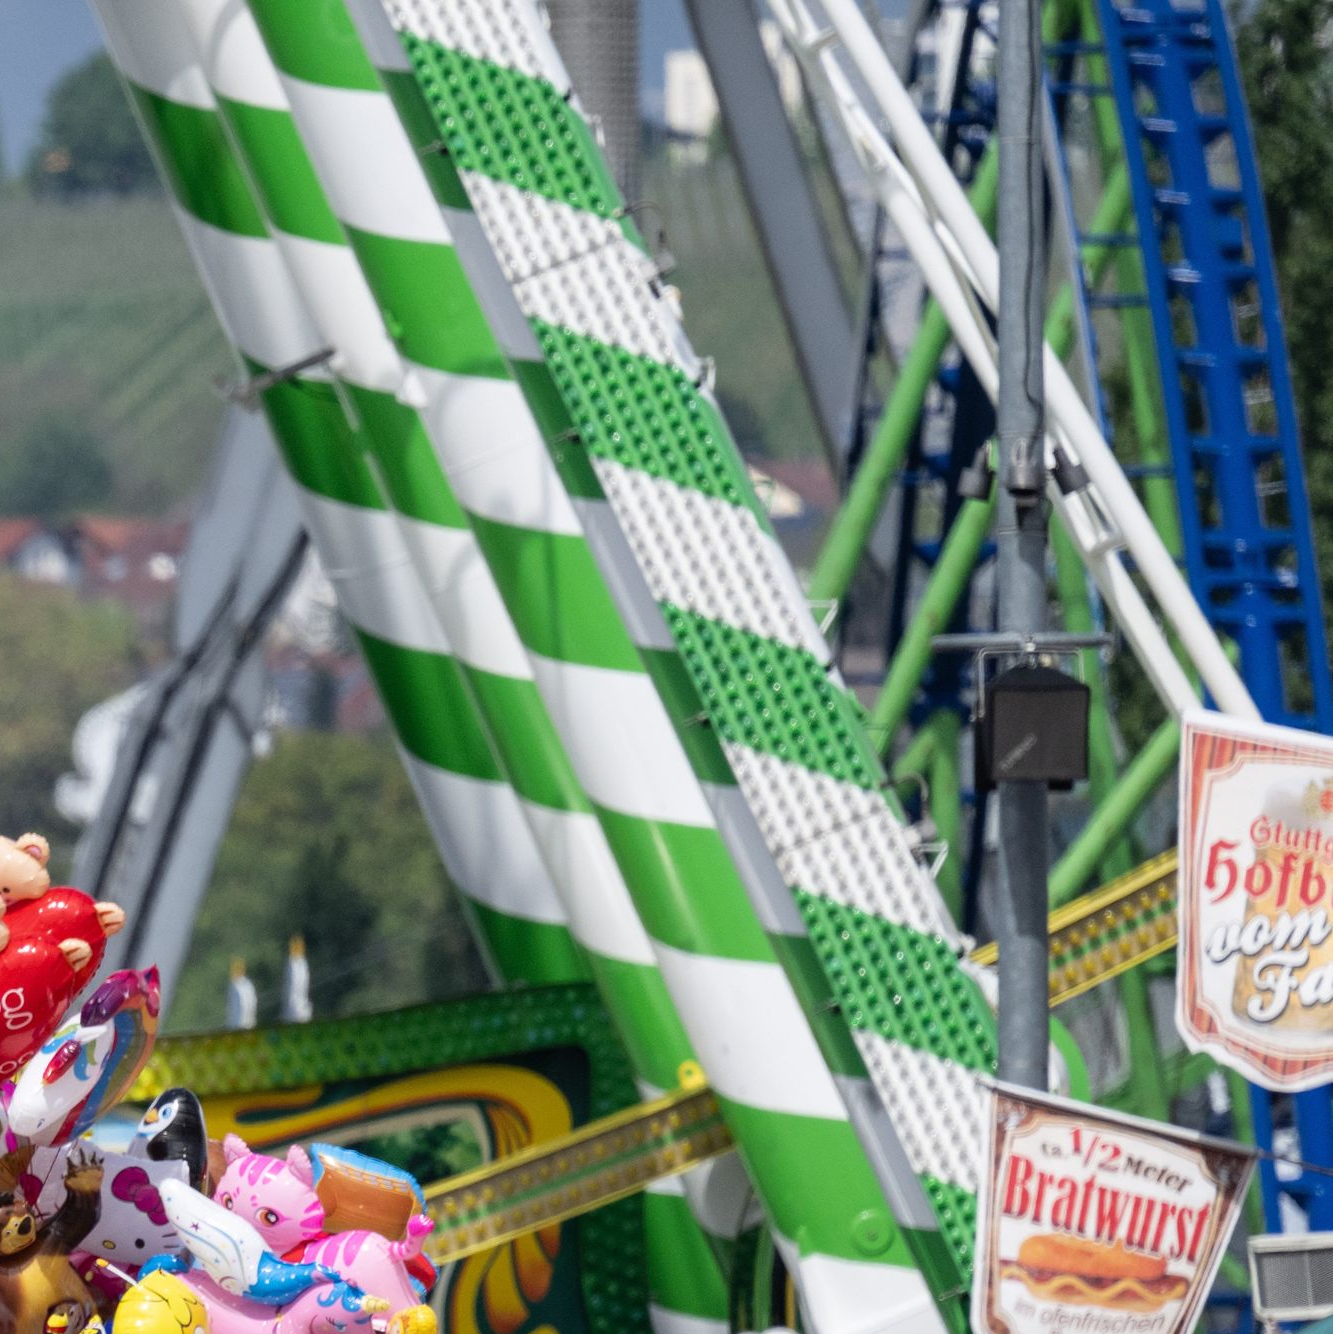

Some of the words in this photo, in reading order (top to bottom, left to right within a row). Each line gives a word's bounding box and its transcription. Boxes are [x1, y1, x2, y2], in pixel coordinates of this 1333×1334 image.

[1204, 838, 1333, 910] Hofb
[1205, 908, 1333, 963] vom
[1068, 1126, 1123, 1173] 1/2
[1123, 1155, 1194, 1193] Meter
[1002, 1154, 1213, 1263] Bratwurst
[1039, 1303, 1166, 1334] ofenfrischen
